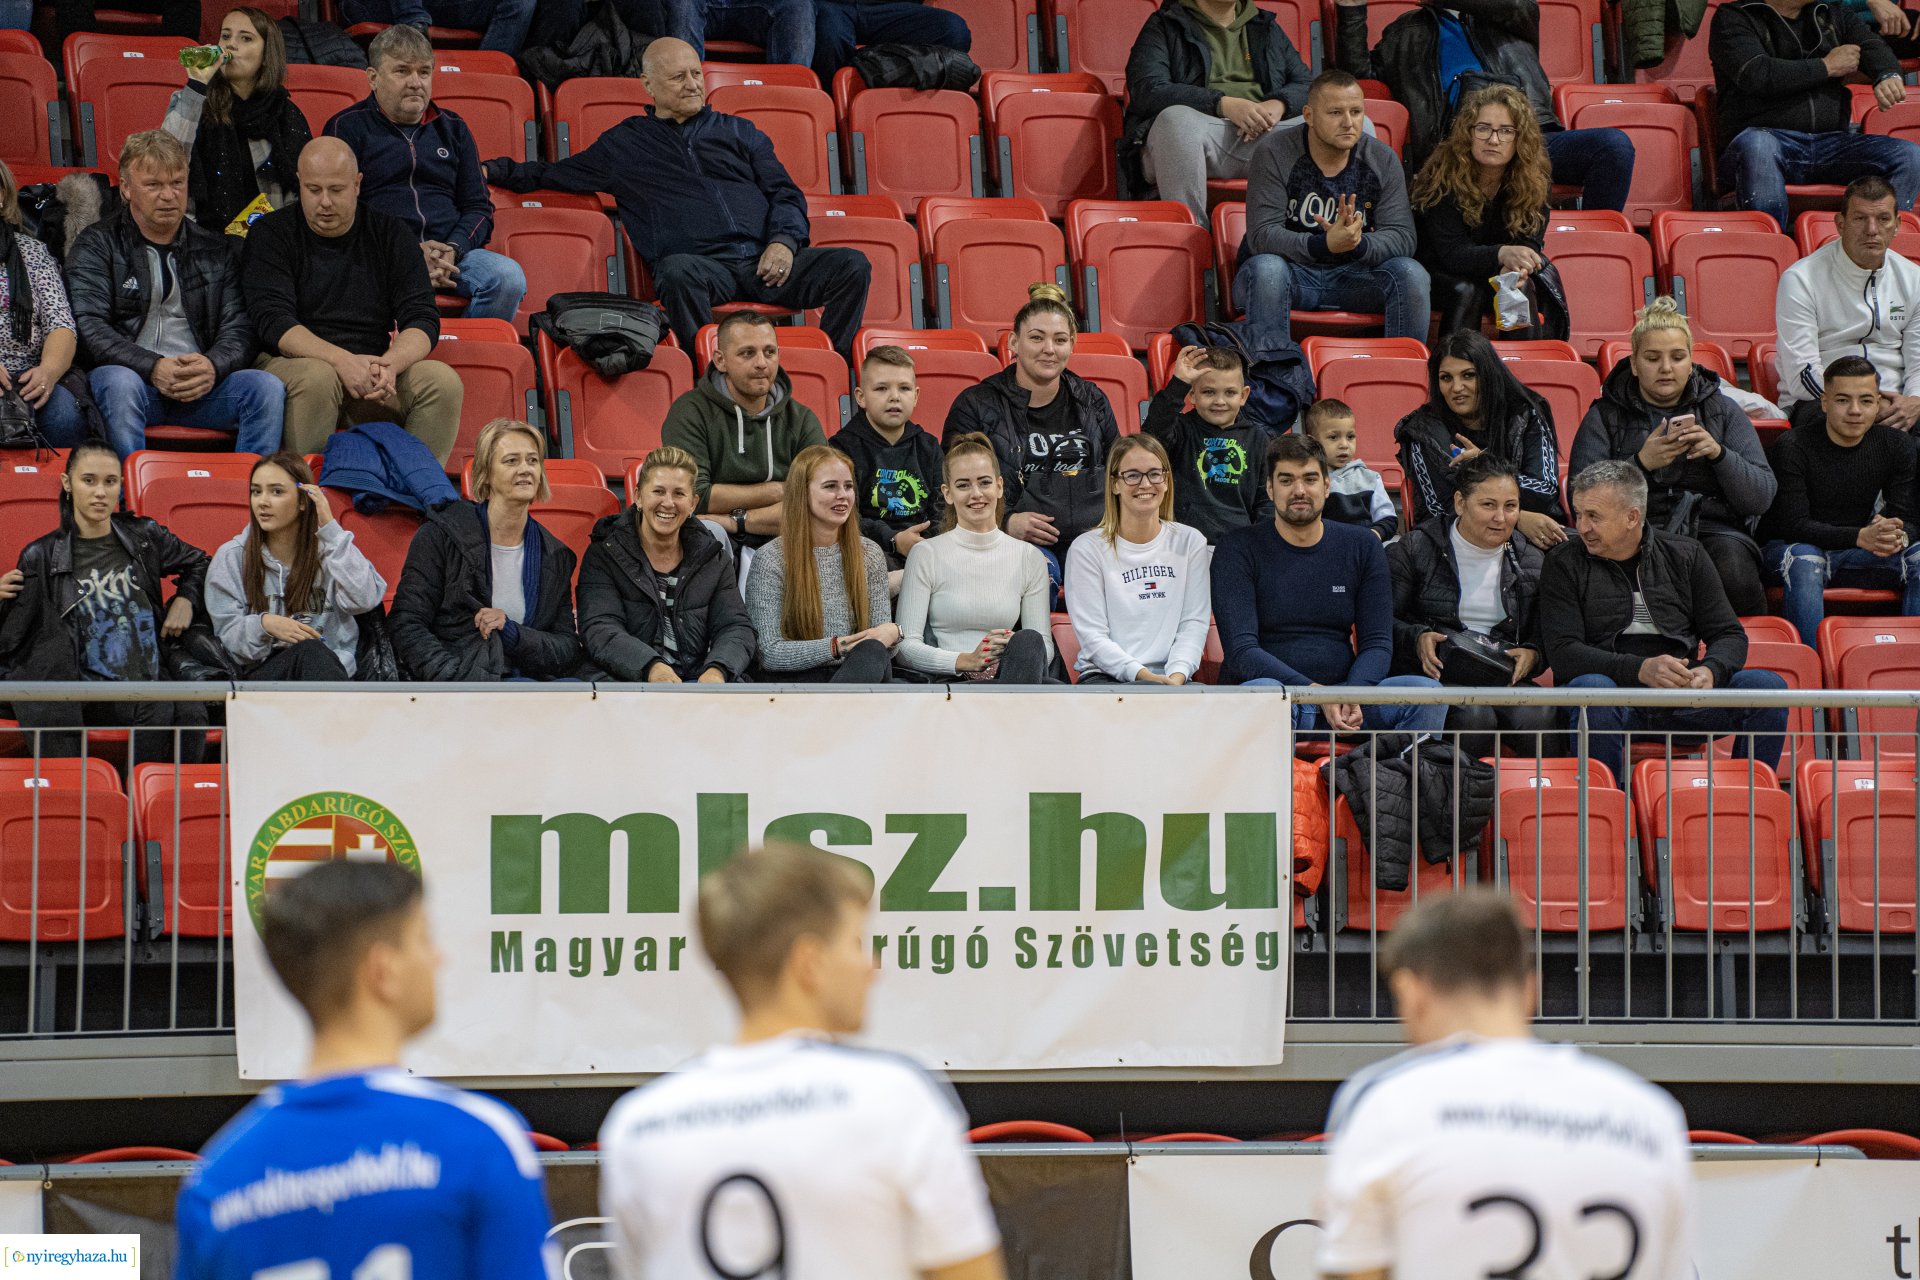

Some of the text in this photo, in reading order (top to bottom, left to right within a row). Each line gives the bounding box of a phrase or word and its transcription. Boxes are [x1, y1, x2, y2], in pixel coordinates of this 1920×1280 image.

[1121, 565, 1176, 584] HILFIGER
[1138, 591, 1166, 601] NEW YORK
[257, 794, 385, 852] LABDARÚGÓ
[384, 823, 418, 868] SZÖ
[491, 922, 1280, 978] Magyar rúgó Szövetség
